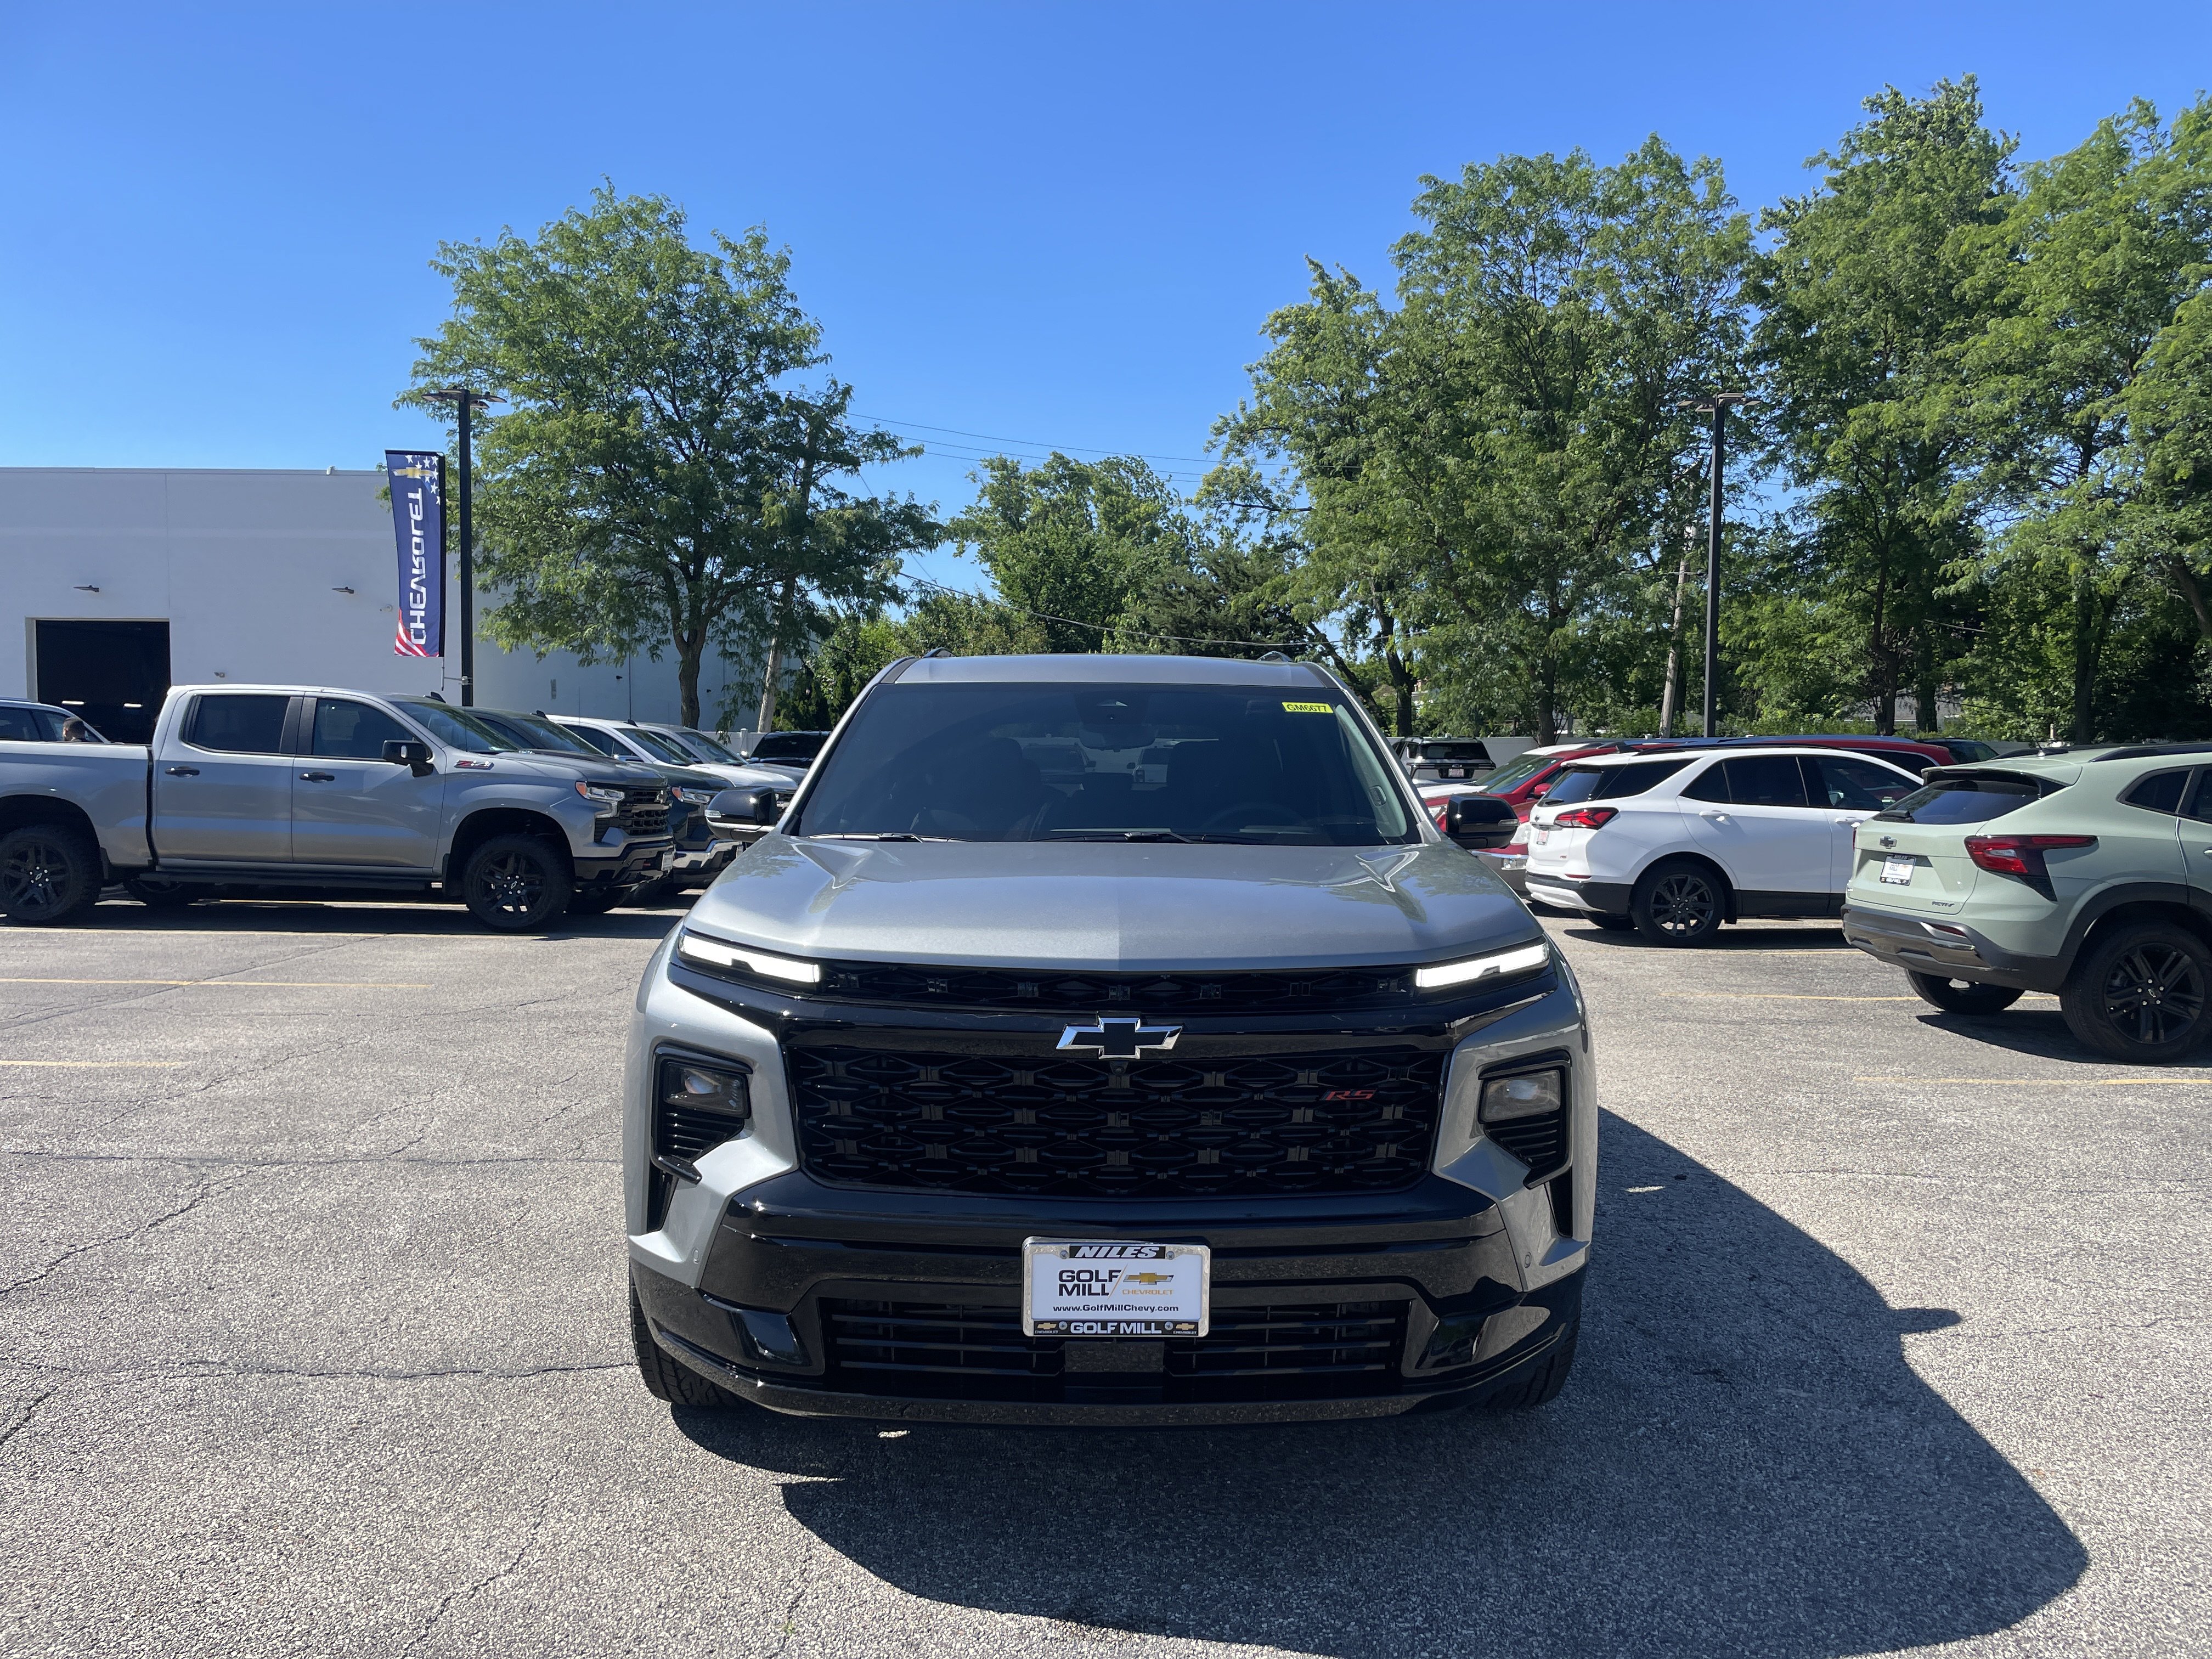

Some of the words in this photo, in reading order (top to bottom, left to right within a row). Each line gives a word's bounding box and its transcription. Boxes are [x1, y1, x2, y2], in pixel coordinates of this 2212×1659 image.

[1286, 704, 1327, 712] GM6677
[1324, 1089, 1376, 1101] RS
[1075, 1246, 1160, 1258] NILES
[1058, 1269, 1122, 1283] GOLF
[1058, 1283, 1110, 1296] MILL
[1053, 1304, 1179, 1312] www.GolfMillChevy.com
[1070, 1322, 1118, 1334] GOLF
[1120, 1322, 1162, 1334] MILL
